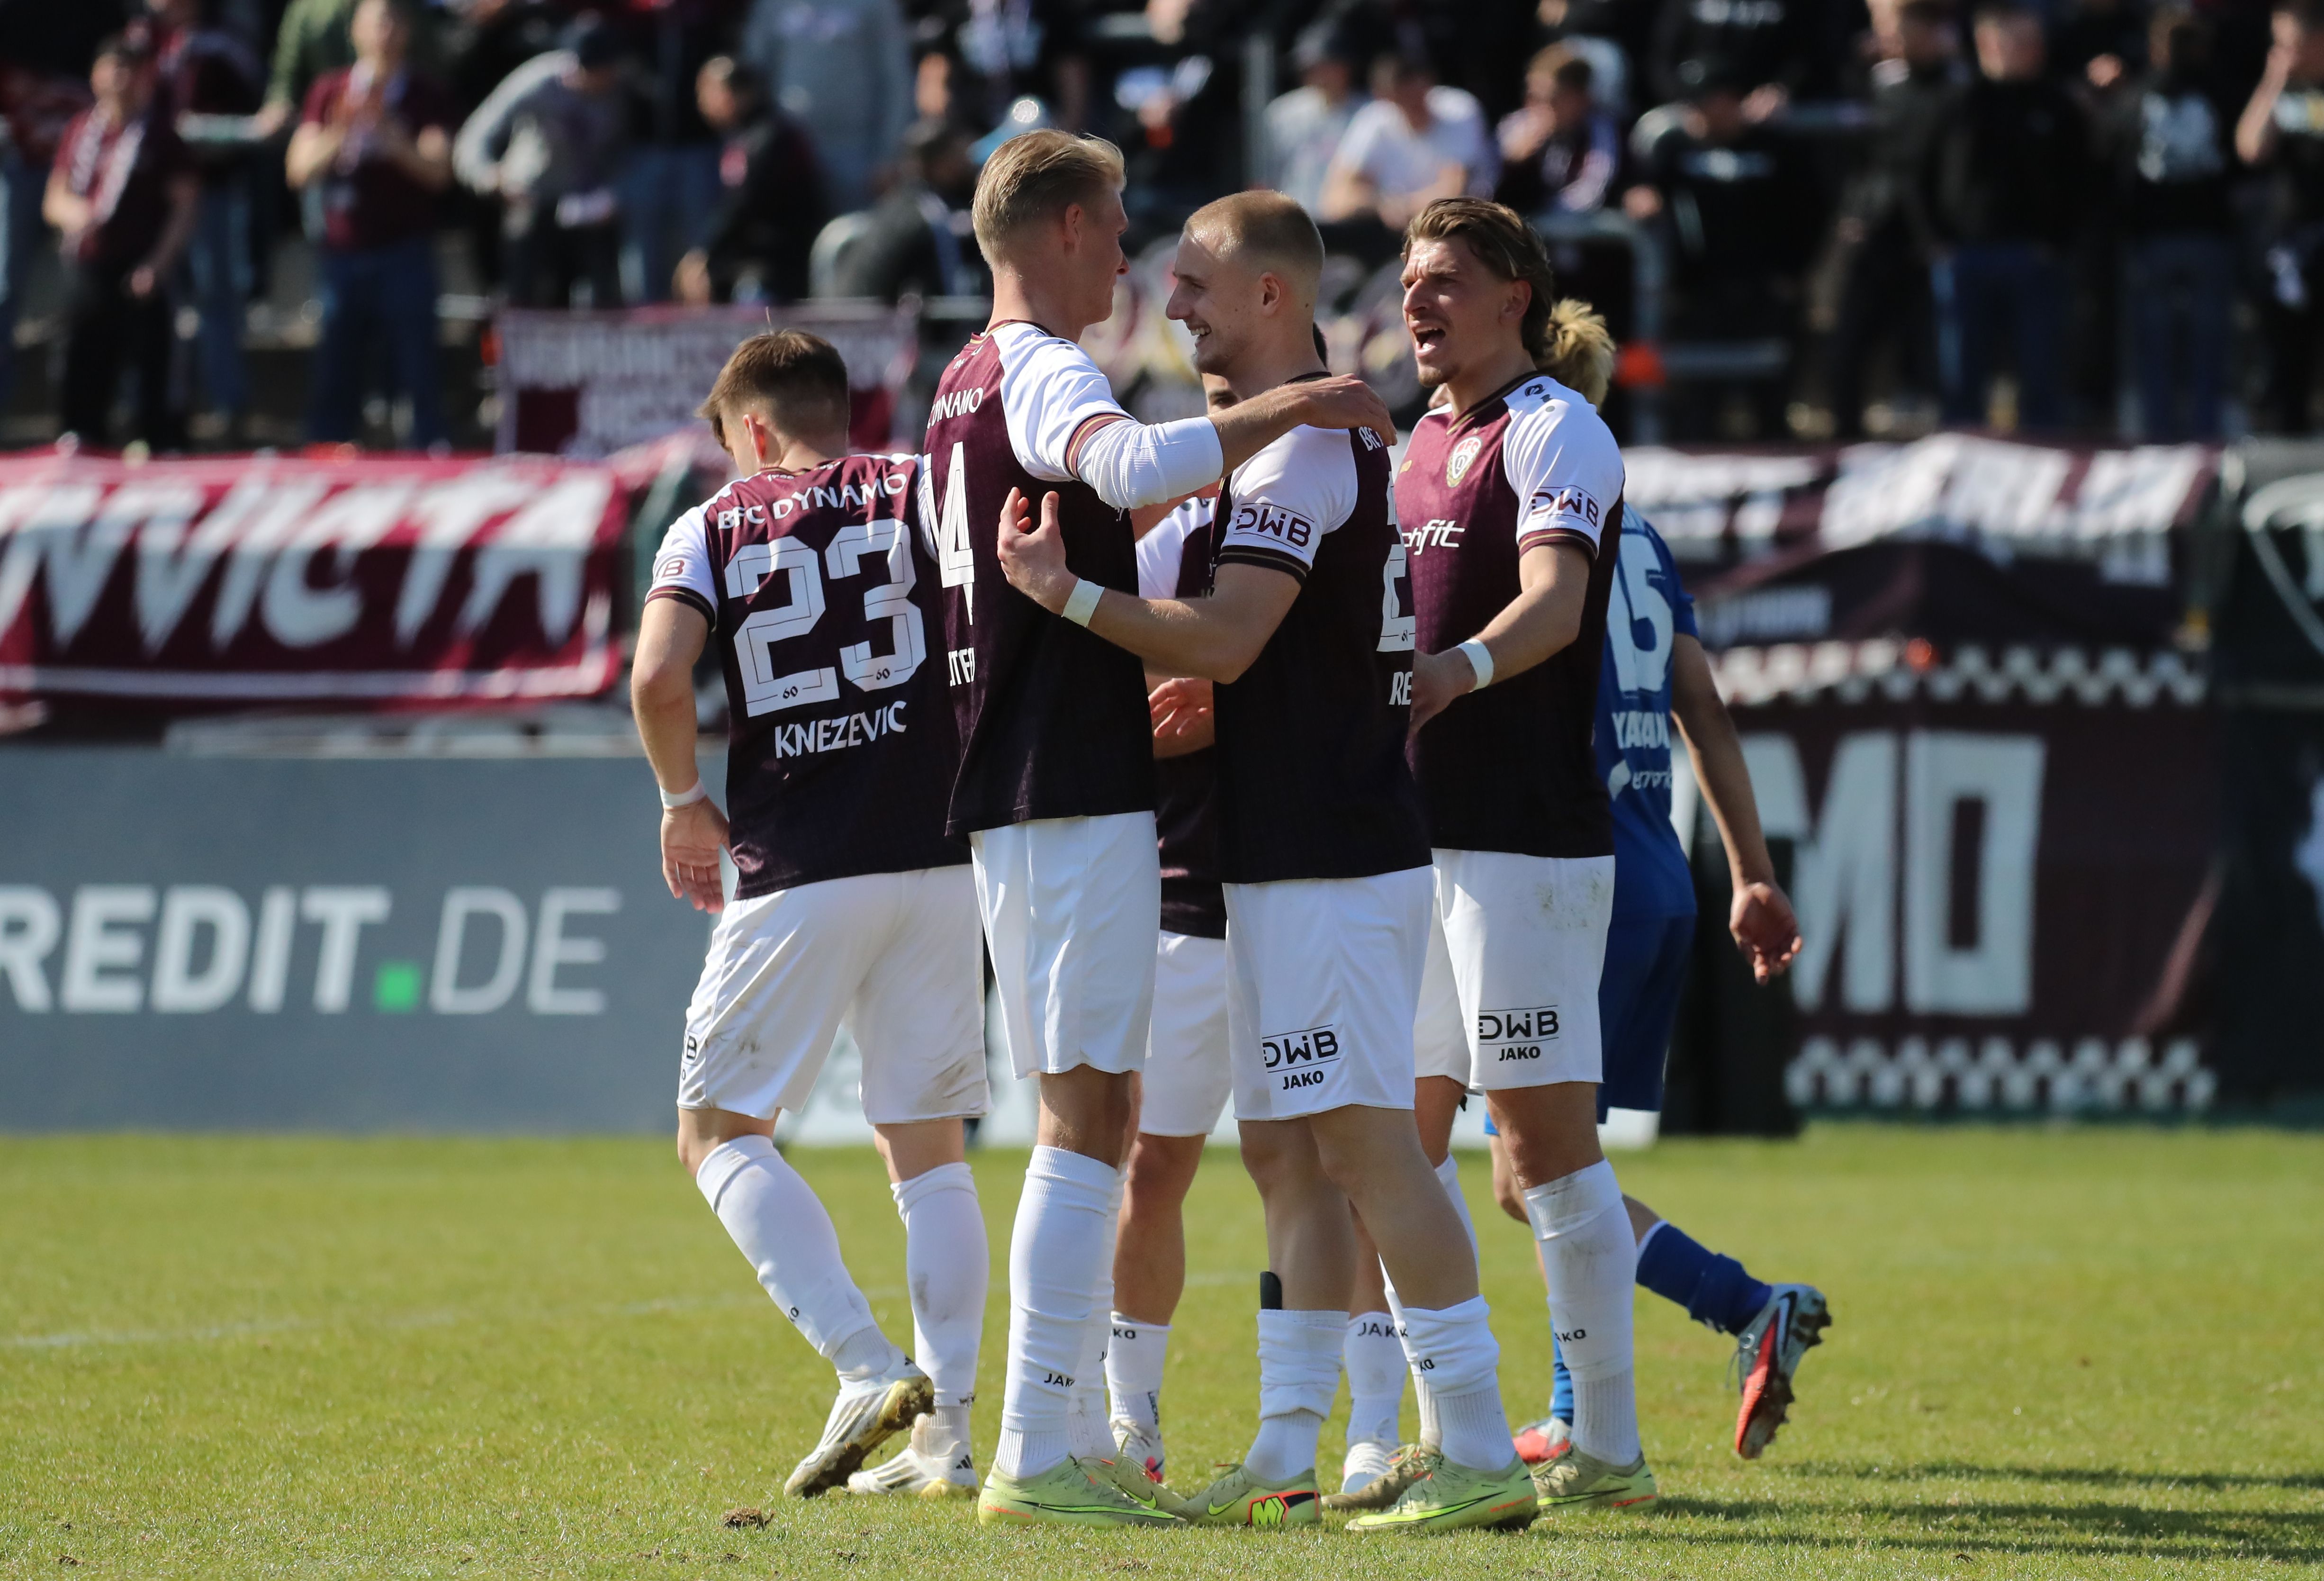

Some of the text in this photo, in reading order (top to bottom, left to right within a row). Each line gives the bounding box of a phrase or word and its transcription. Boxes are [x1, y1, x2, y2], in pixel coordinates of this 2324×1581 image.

[718, 474, 907, 529] BFC DYNAMO
[724, 518, 927, 718] 23
[877, 668, 891, 680] 60
[783, 686, 798, 699] 60
[775, 700, 907, 759] KNEZEVIC
[1498, 1046, 1541, 1061] JAKO
[1283, 1070, 1324, 1090] JAKO
[1113, 1328, 1136, 1339] KO
